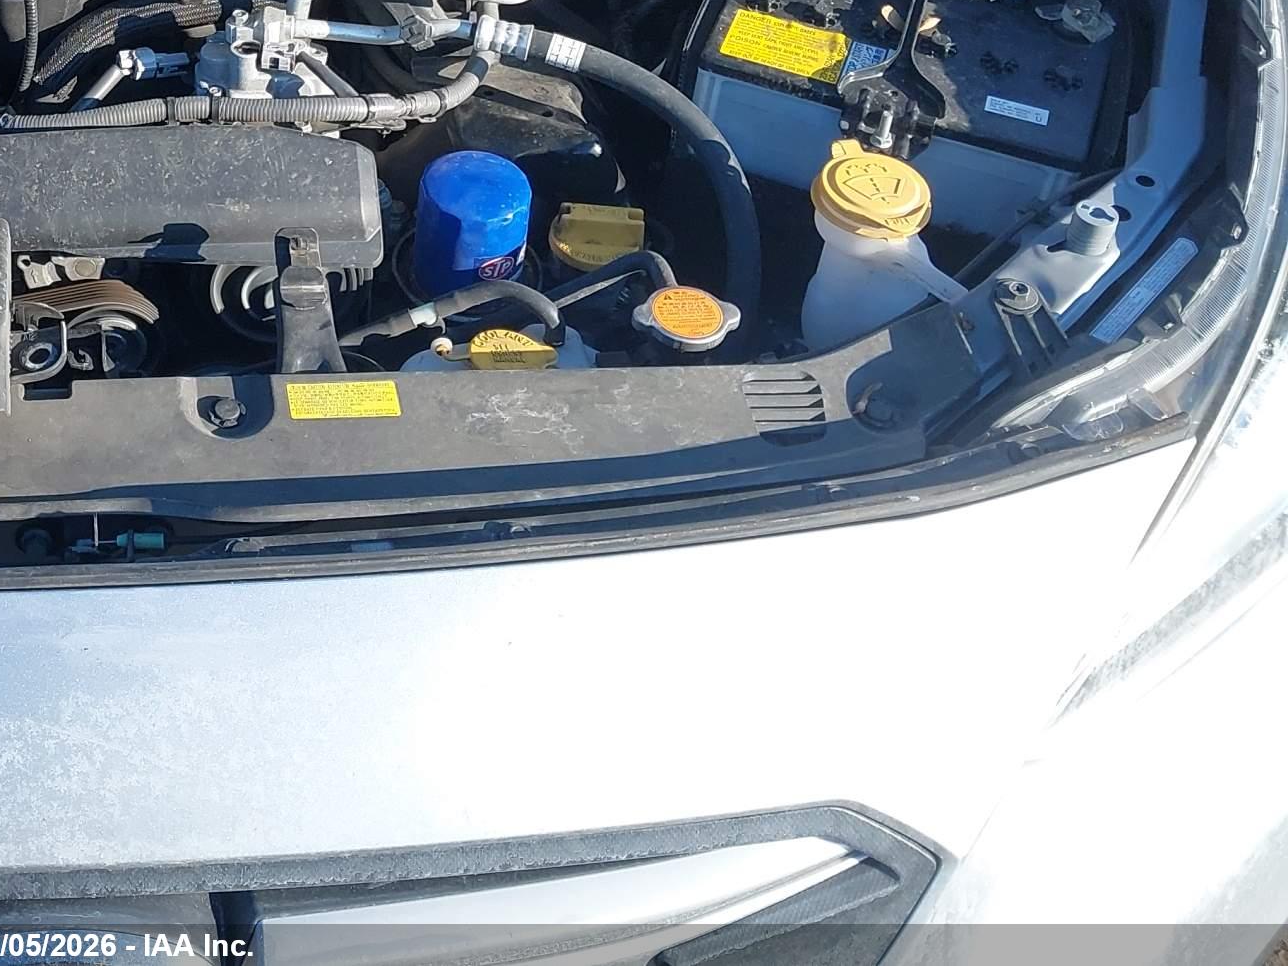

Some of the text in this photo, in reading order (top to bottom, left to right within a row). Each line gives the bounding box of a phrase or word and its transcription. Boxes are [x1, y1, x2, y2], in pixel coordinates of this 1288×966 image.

[739, 12, 772, 23] DANGER
[729, 33, 761, 46] POISON
[483, 259, 511, 277] STP
[473, 331, 535, 348] COOLANT
